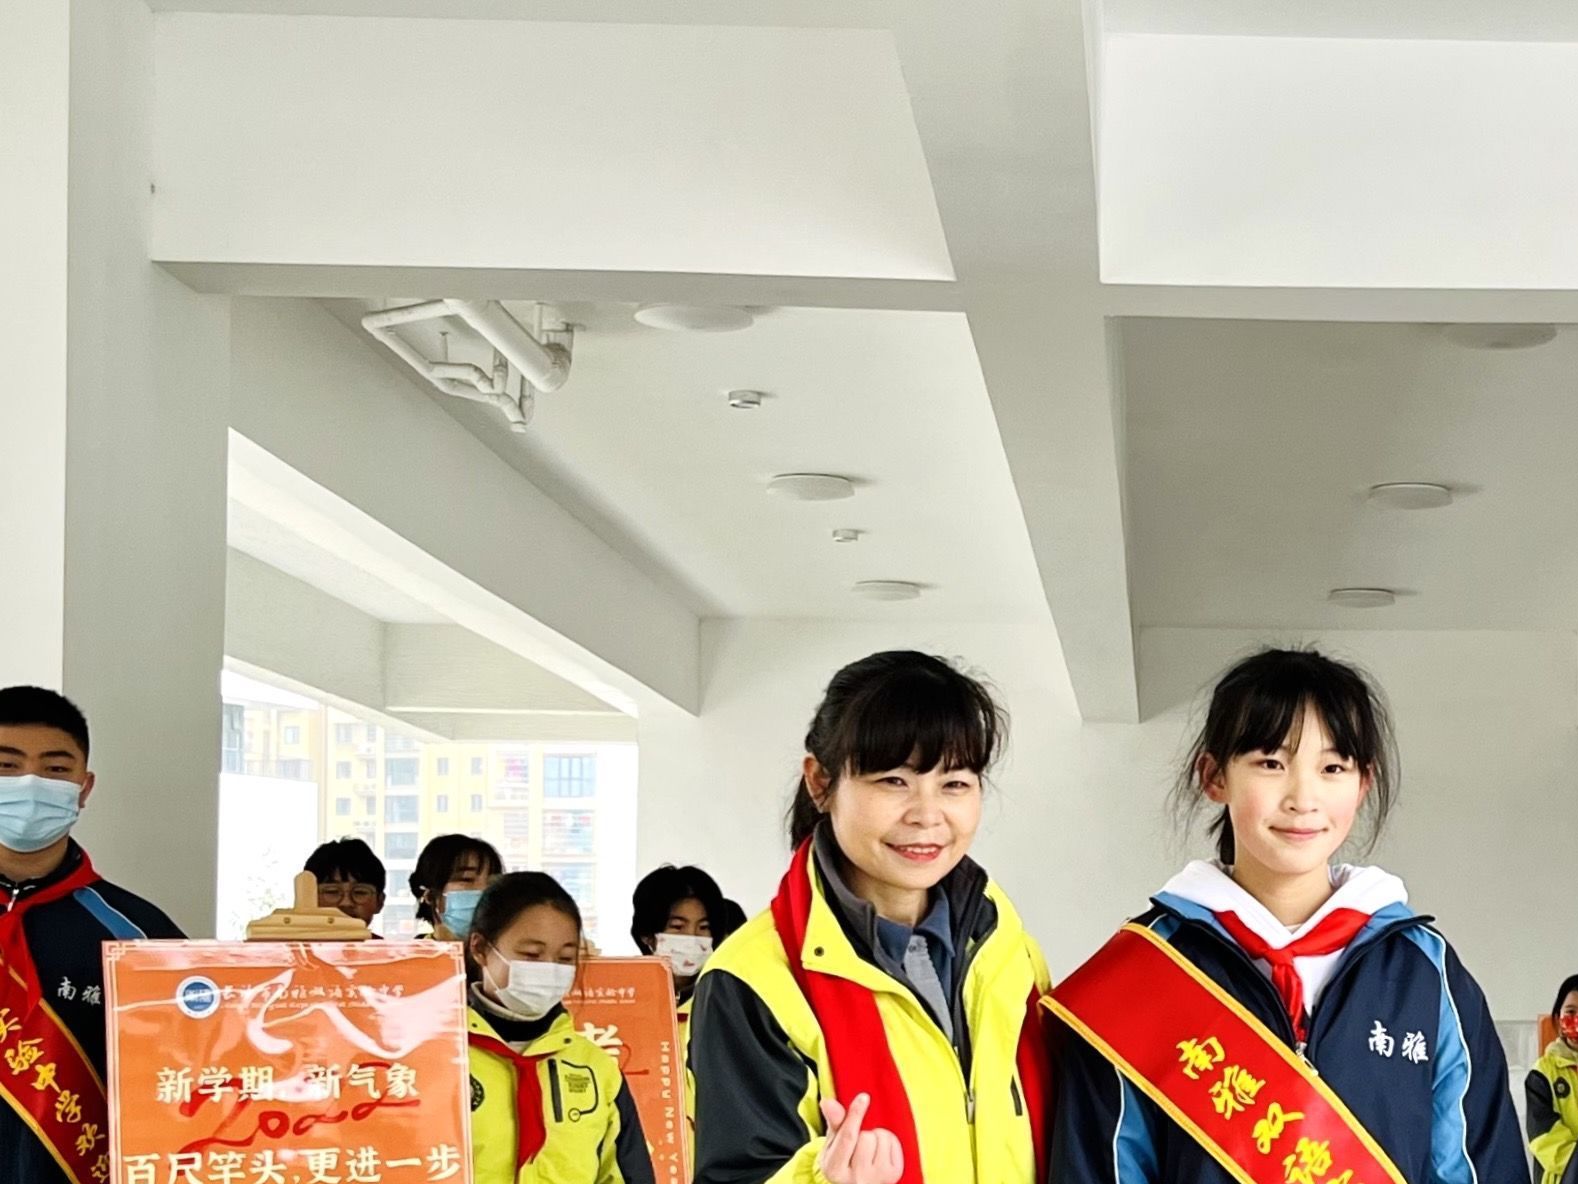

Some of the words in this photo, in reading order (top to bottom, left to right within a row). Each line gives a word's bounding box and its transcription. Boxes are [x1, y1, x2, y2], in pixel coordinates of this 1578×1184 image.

[1368, 1020, 1429, 1064] 南雅
[660, 1040, 672, 1100] Happy
[664, 1106, 677, 1145] New
